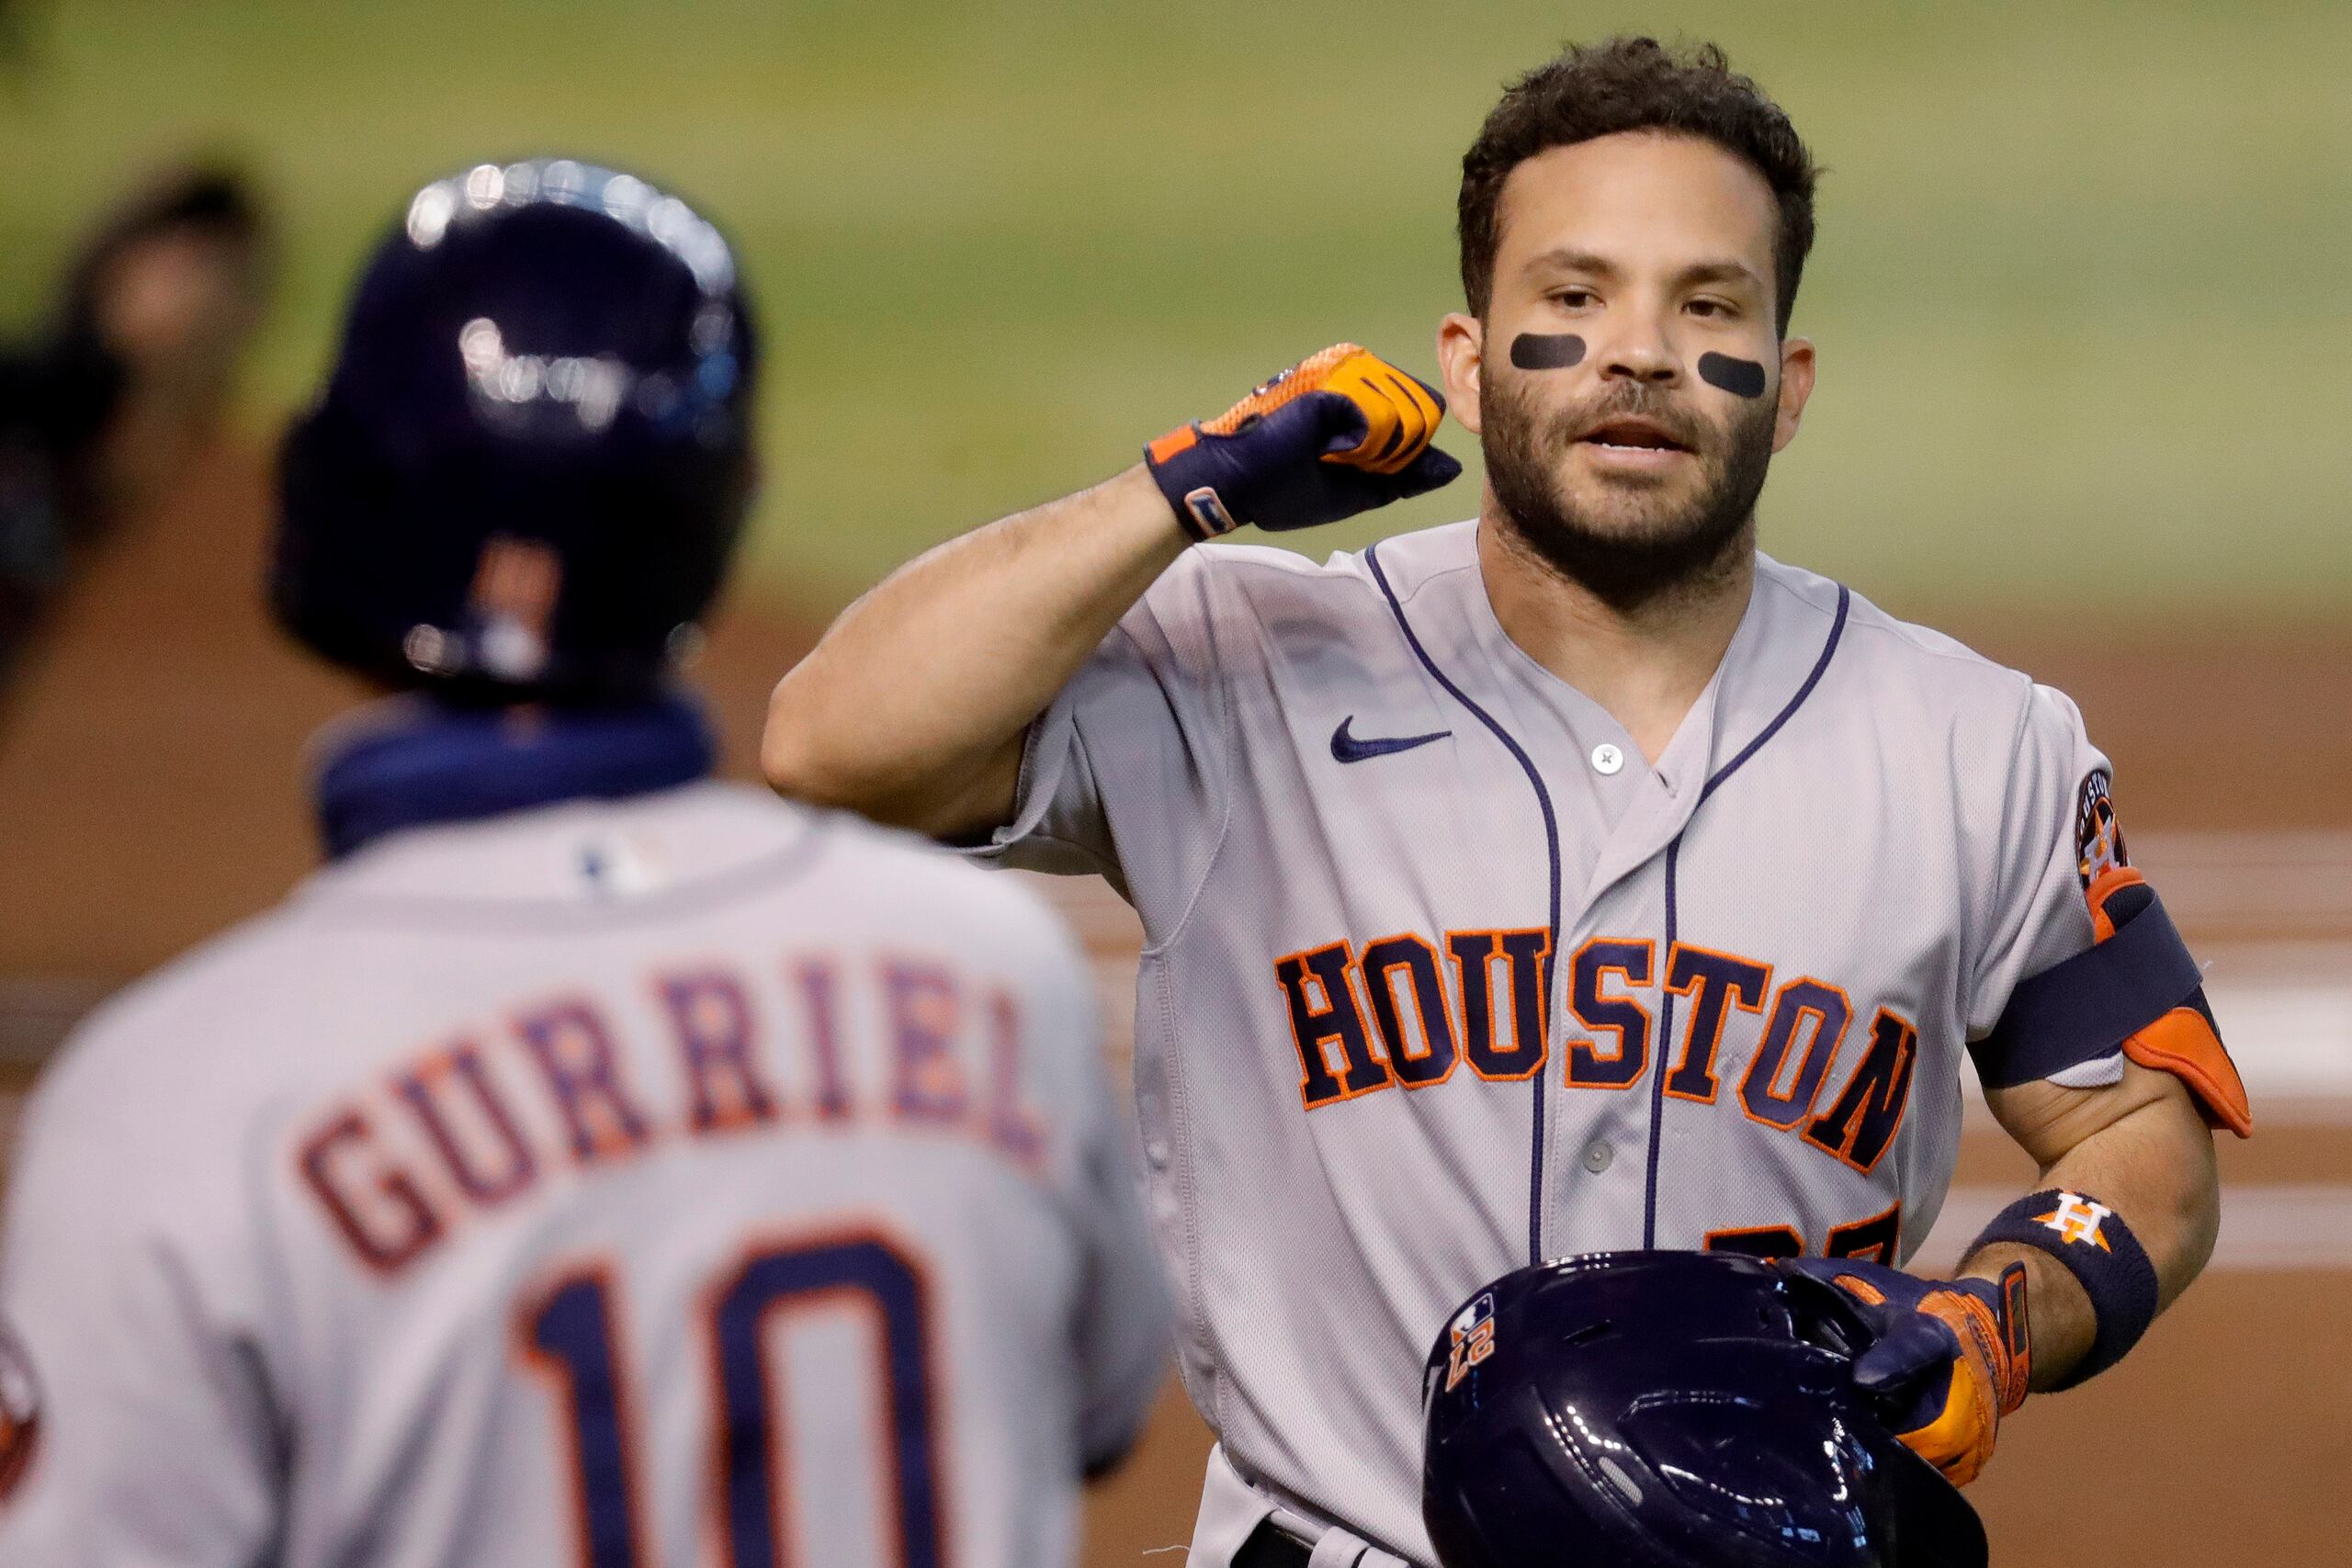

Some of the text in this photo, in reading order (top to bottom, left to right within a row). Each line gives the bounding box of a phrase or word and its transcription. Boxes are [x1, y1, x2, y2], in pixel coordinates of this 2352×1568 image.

[296, 951, 1053, 1277] GURRIEL
[1274, 927, 1917, 1175] HOUSTON
[2044, 1193, 2111, 1247] H
[512, 1224, 946, 1568] 10
